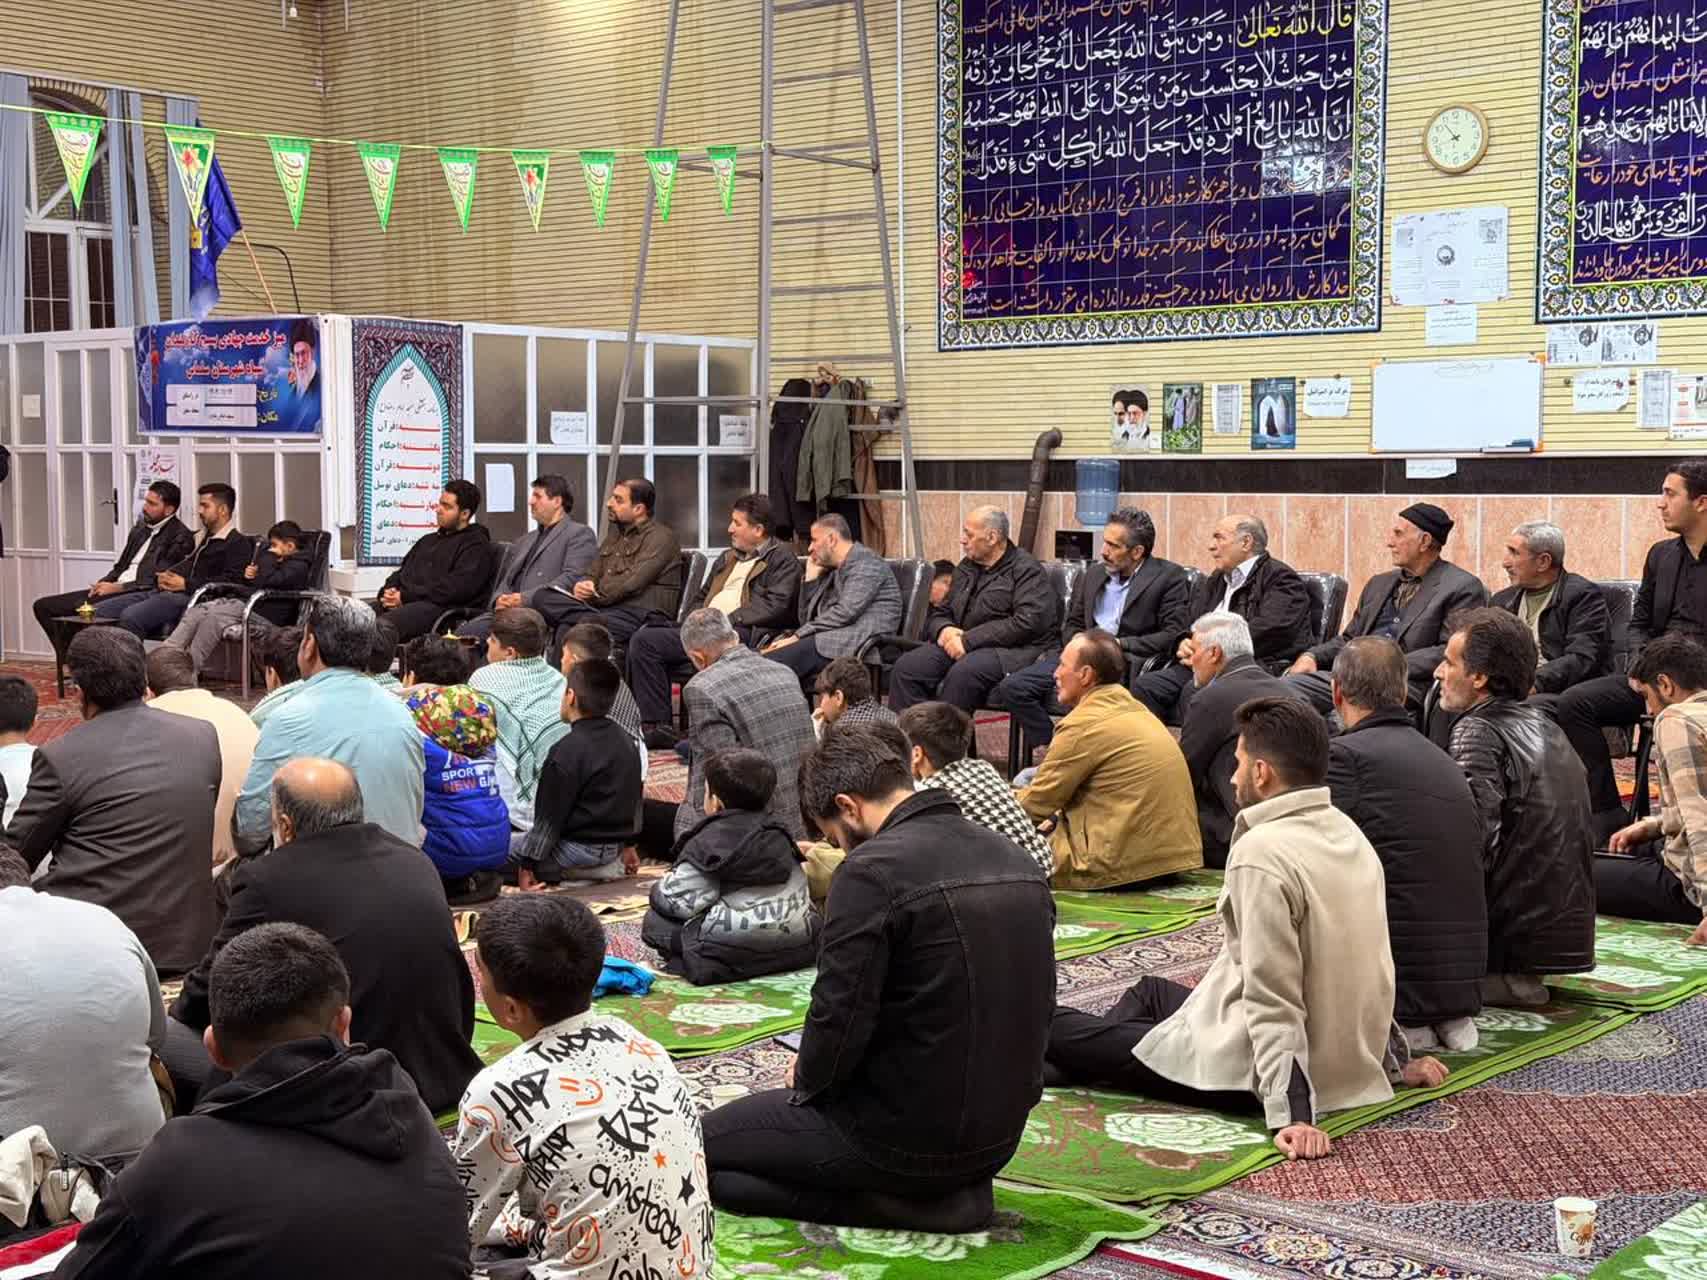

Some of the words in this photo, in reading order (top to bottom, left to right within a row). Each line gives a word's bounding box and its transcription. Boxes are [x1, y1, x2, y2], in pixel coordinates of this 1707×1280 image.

[1284, 0, 1316, 36] الله
[1318, 0, 1353, 35] قال
[1124, 18, 1152, 58] الله
[1041, 85, 1069, 123] الله
[1295, 97, 1327, 139] الله
[1105, 122, 1133, 158] الله
